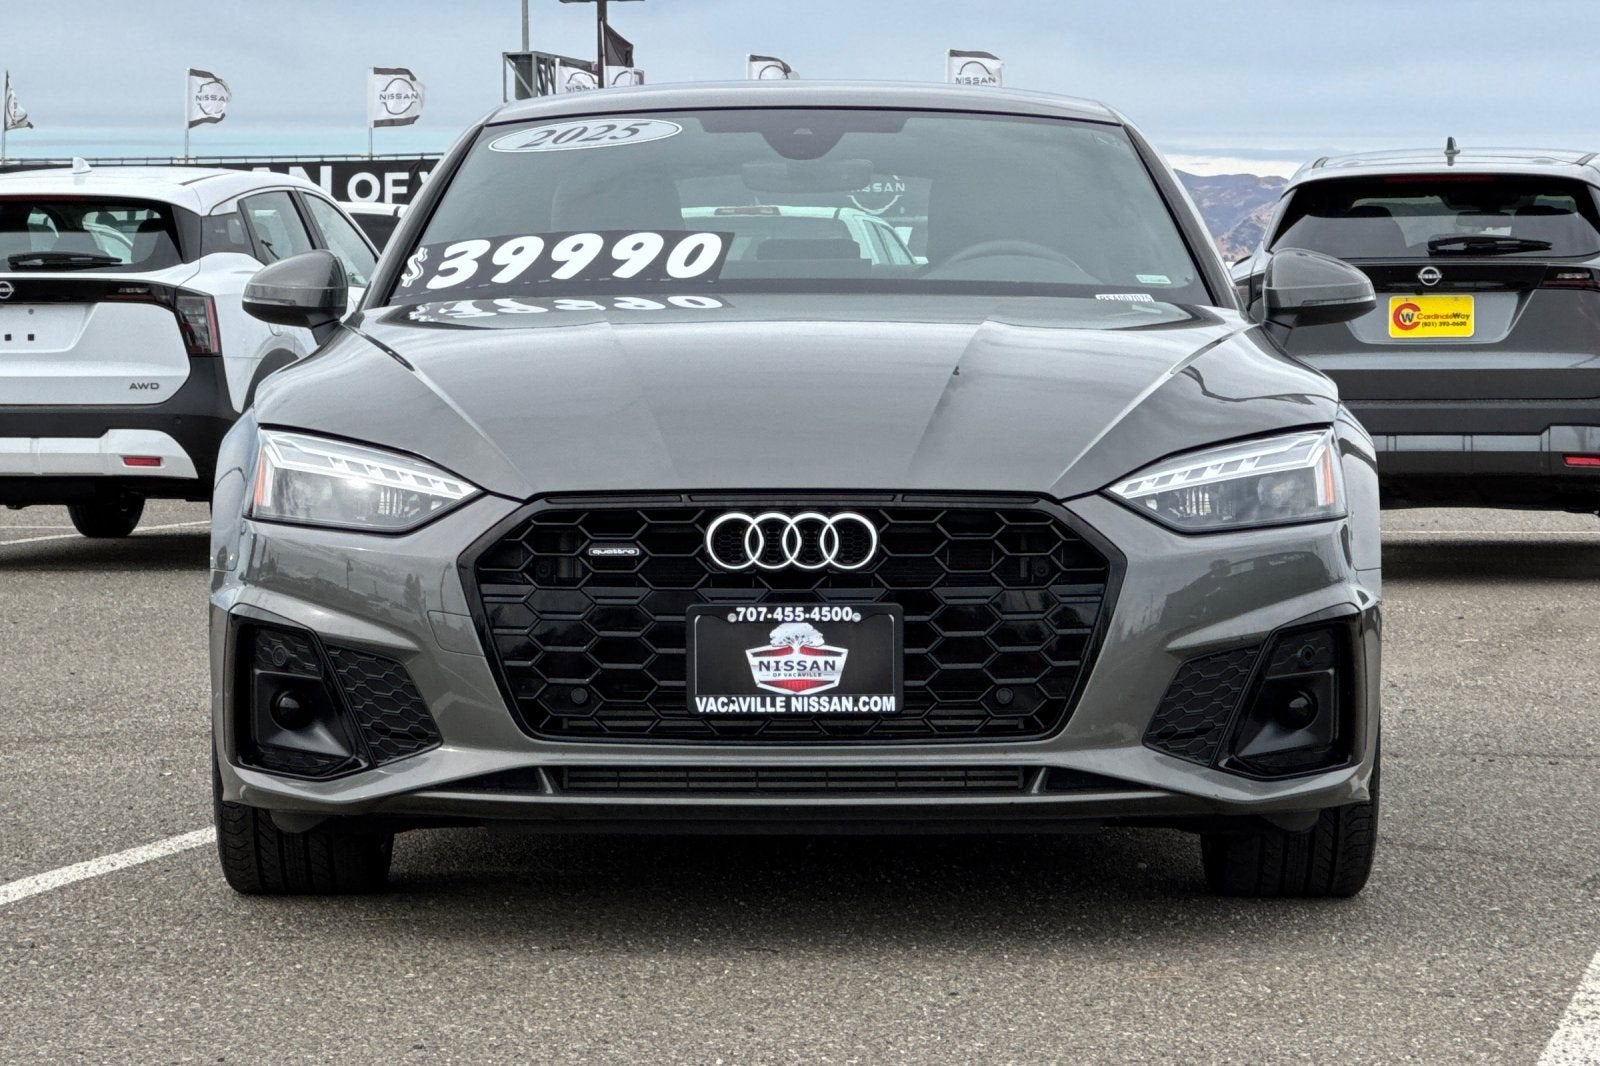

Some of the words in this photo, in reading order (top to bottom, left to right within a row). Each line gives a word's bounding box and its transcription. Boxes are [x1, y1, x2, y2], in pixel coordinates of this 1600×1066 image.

[955, 76, 997, 86] NISSAN
[379, 93, 419, 101] NISSAN
[518, 122, 651, 149] 2025
[347, 172, 410, 204] OF
[401, 232, 722, 290] $39990
[129, 382, 160, 390] AWD
[758, 660, 836, 672] NISSAN
[695, 696, 786, 713] VACAVILLE
[791, 696, 896, 712] NISSAN.COM
